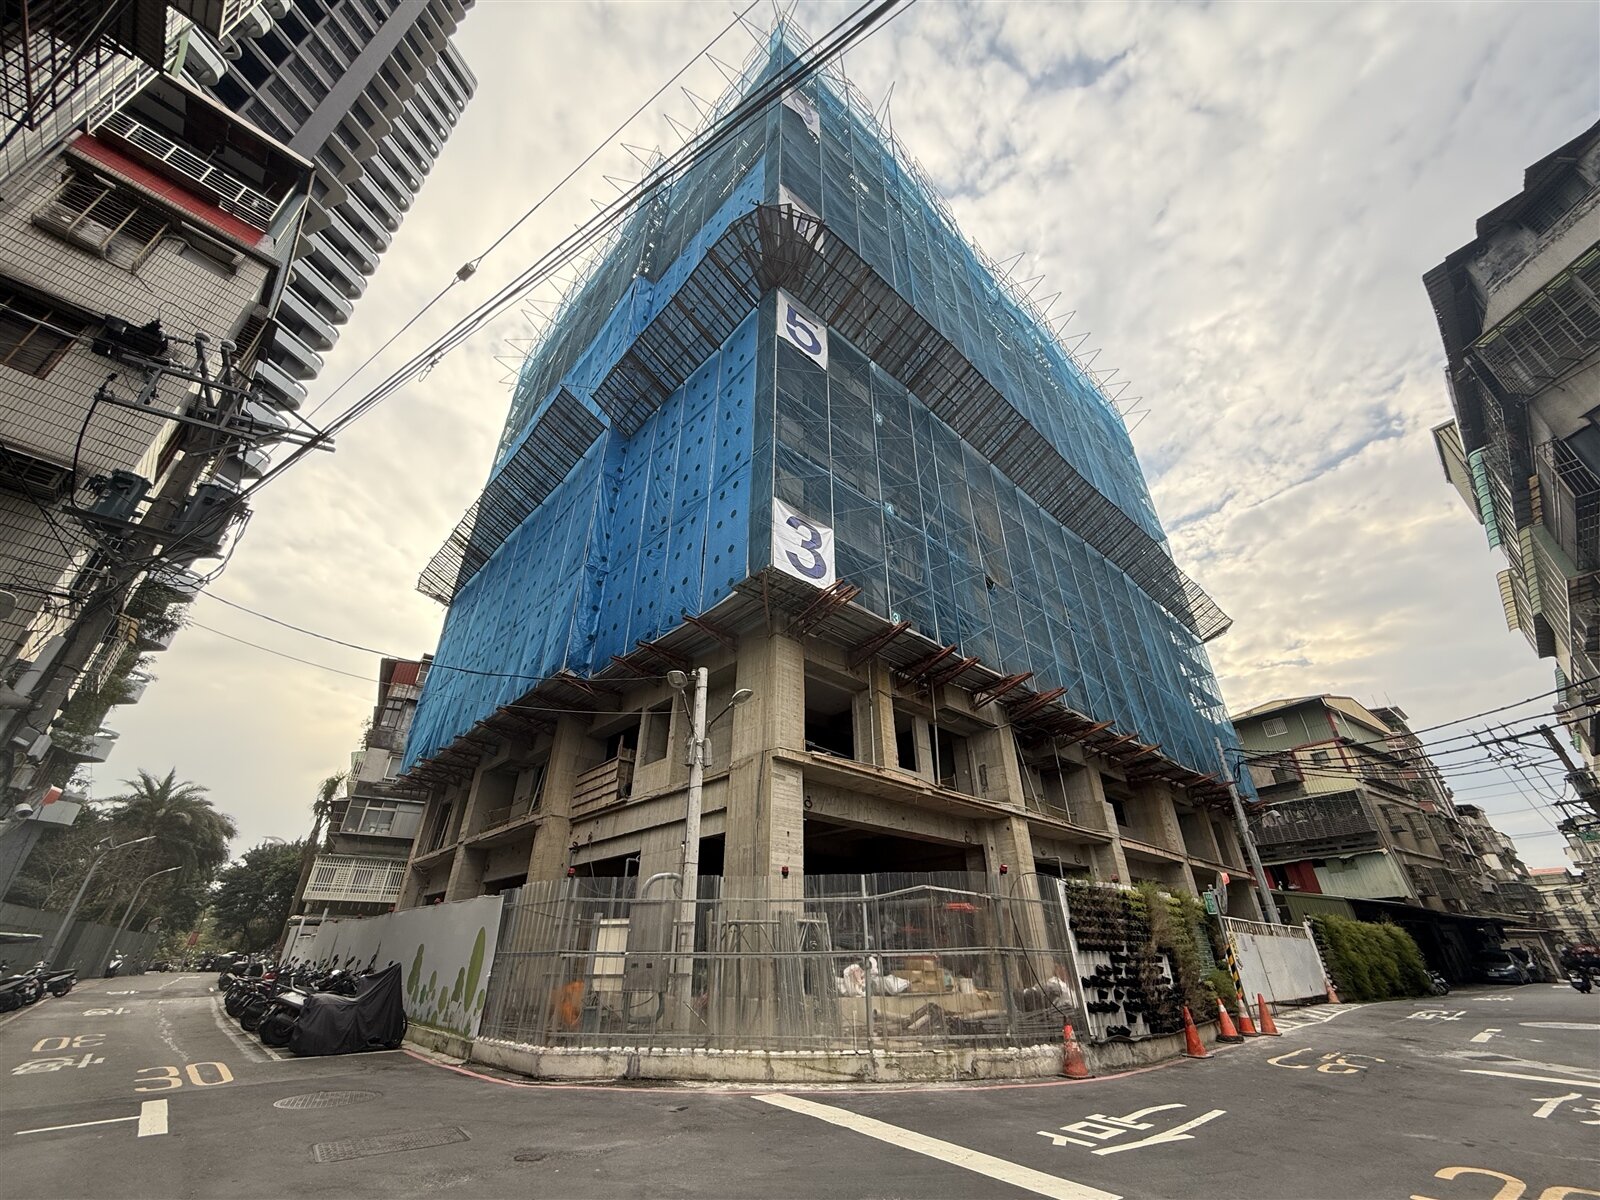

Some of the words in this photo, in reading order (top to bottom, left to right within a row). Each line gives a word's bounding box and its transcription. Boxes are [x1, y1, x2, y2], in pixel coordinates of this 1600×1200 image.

[786, 303, 822, 355] 5
[785, 515, 827, 579] 3
[32, 1033, 107, 1052] 30
[134, 1061, 234, 1092] 30
